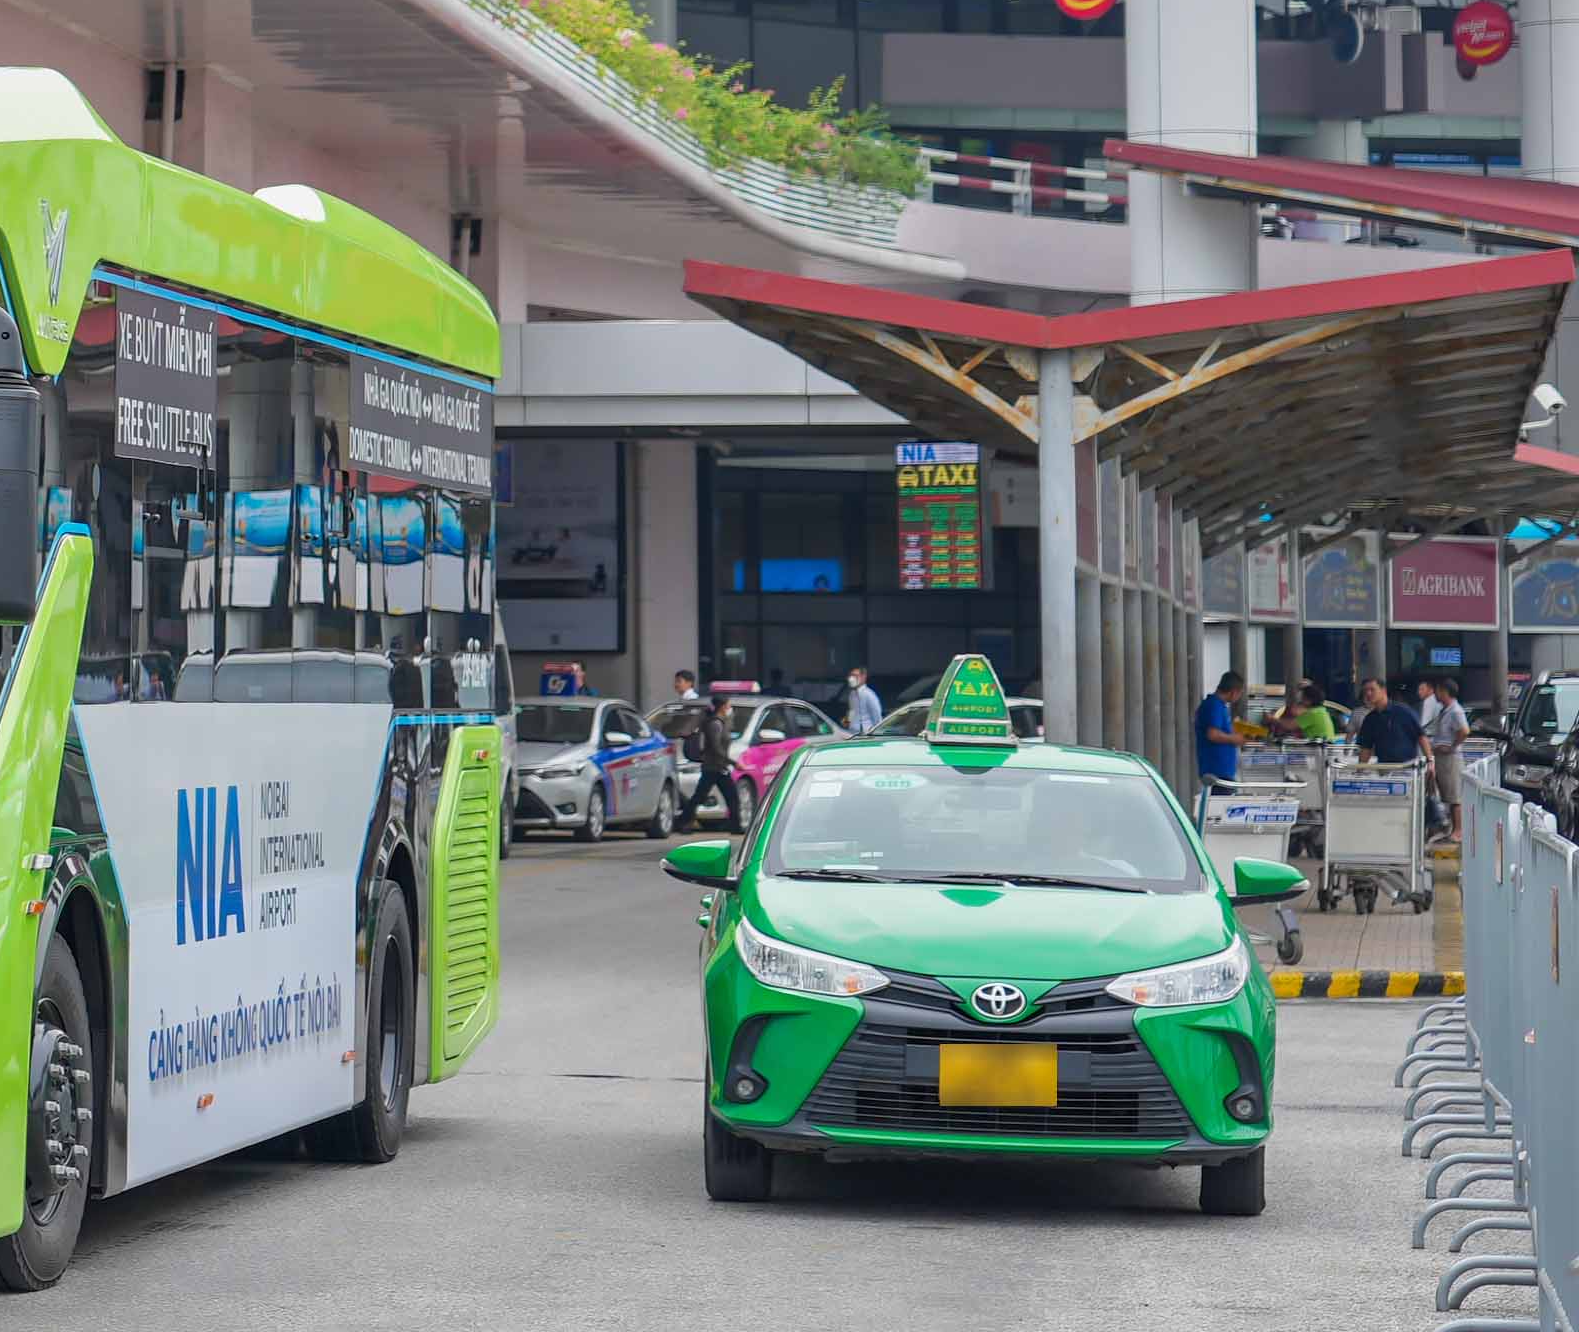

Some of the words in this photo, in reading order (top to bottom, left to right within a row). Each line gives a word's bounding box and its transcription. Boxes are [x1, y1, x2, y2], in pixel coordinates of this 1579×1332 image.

[118, 310, 134, 362] XE
[135, 307, 164, 367] BUÝT
[165, 305, 193, 374] MIỄN
[195, 321, 214, 378] PHÍ
[363, 365, 380, 408] NHÀ
[380, 376, 391, 411] GA
[117, 396, 144, 447] FREE
[145, 401, 190, 453] SHUTTLE
[188, 411, 213, 458] BUS
[349, 426, 383, 467] DOMESTIC
[421, 444, 467, 484] INTERNATIONAL
[901, 443, 937, 461] NIA
[918, 464, 978, 486] TAXI
[1417, 572, 1486, 597] AGRIBANK
[260, 780, 290, 821] NOIBAI
[176, 784, 246, 947] NIA
[259, 831, 325, 875] INTERNATIONAL
[259, 887, 298, 931] AIRPORT
[148, 1007, 184, 1082] CẢNG
[186, 1004, 218, 1071] HÀNG
[220, 995, 257, 1061] KHÔNG
[258, 976, 292, 1055] QUỐC
[293, 971, 306, 1037] TẾ
[307, 974, 325, 1045] NỘI
[327, 971, 342, 1031] BÀI
